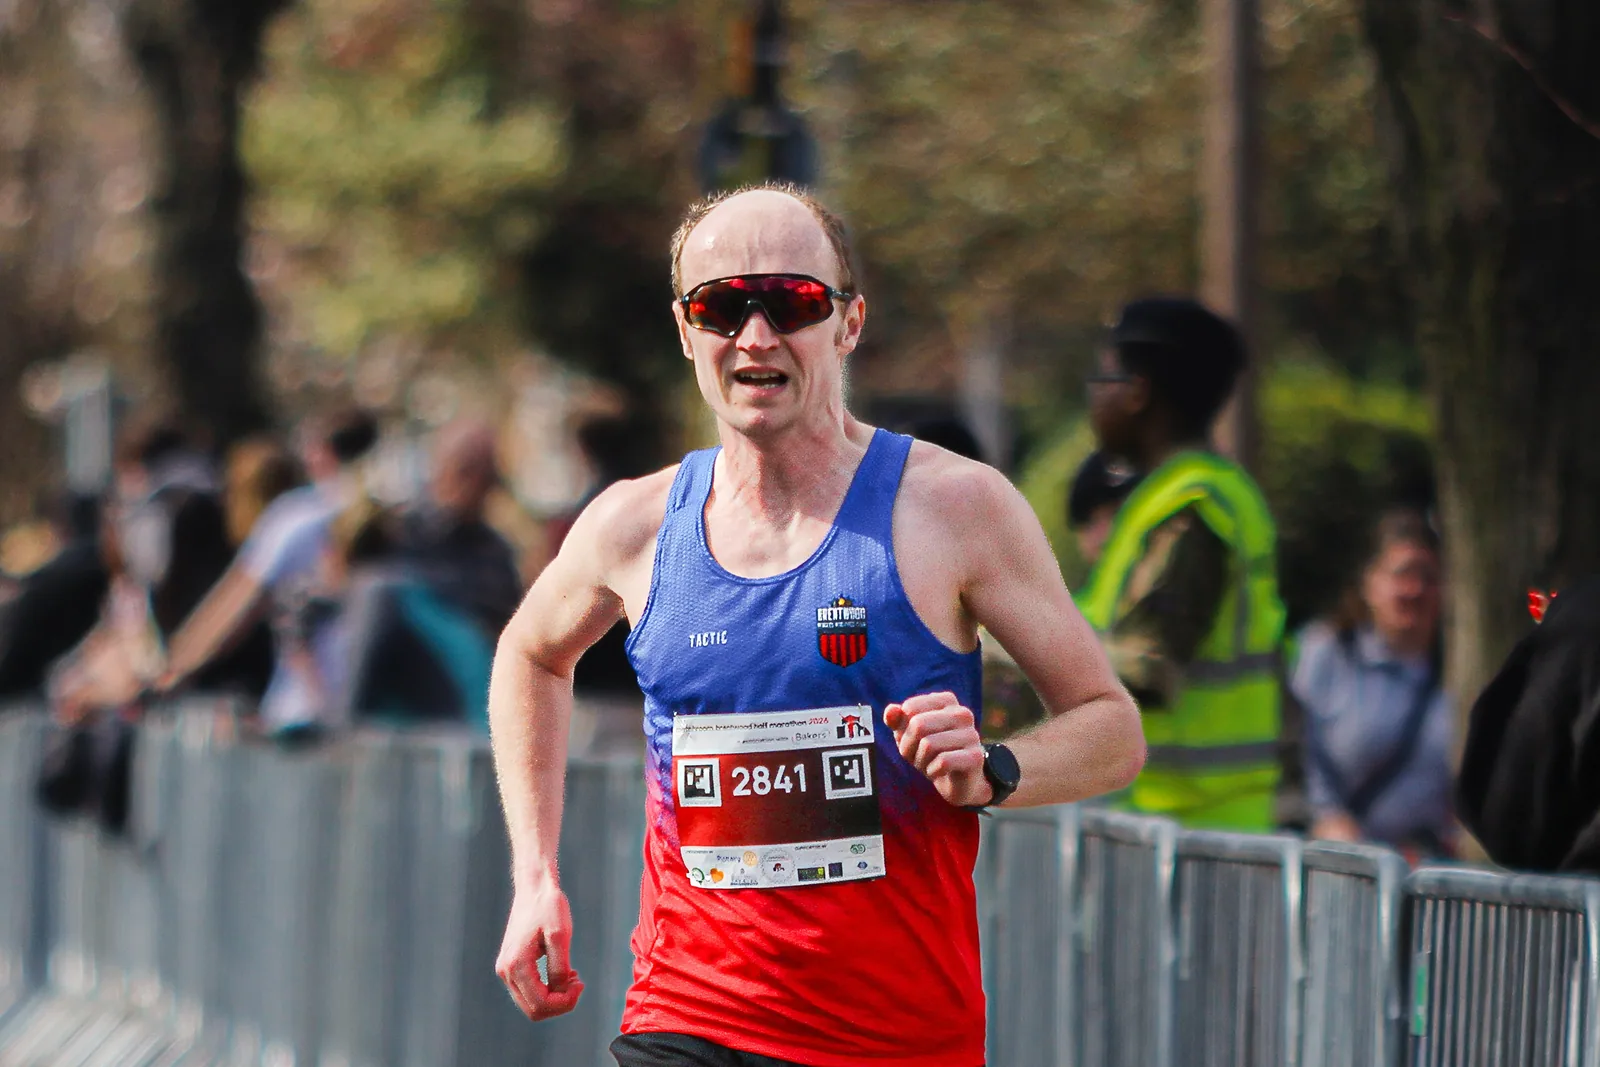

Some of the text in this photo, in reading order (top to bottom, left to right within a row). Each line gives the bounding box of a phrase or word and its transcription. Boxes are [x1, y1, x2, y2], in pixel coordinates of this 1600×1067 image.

[689, 630, 728, 648] TACTIC
[754, 722, 768, 730] half
[769, 720, 807, 729] marathon
[809, 717, 829, 725] 2026
[732, 764, 807, 796] 2841
